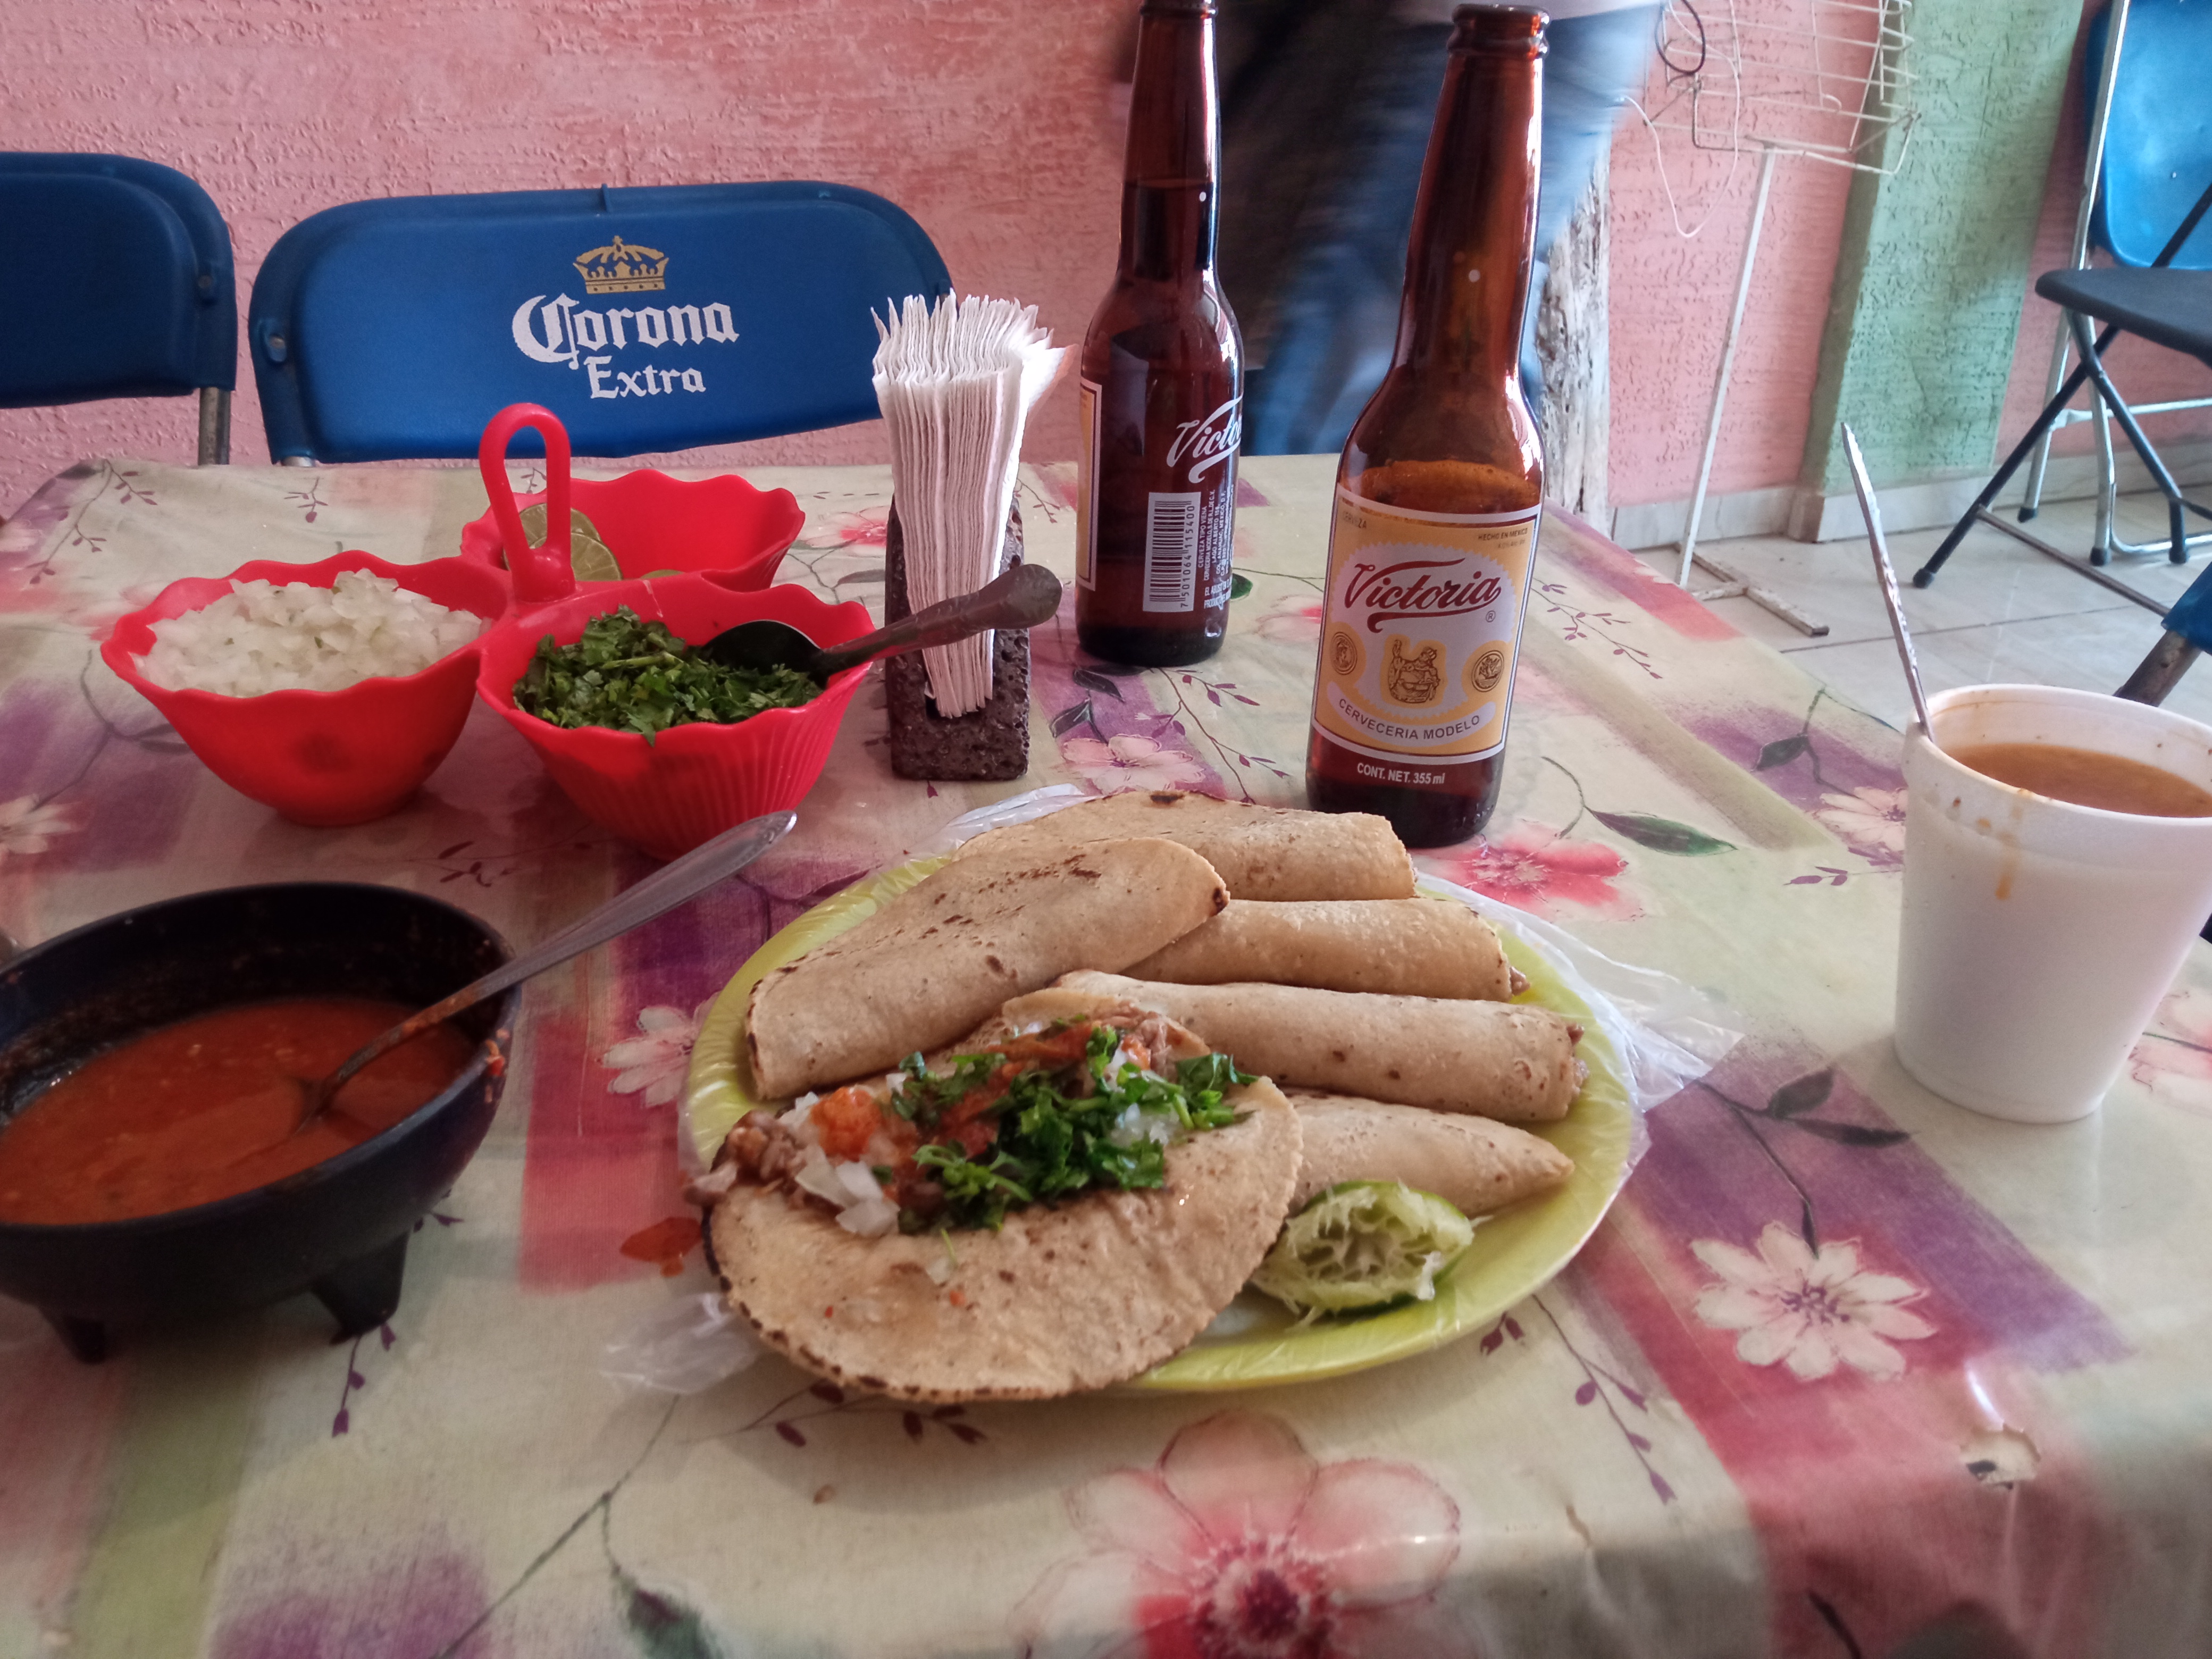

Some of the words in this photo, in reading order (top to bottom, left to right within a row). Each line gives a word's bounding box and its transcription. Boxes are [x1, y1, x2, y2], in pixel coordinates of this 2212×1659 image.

[512, 293, 740, 370] Corona
[584, 355, 706, 399] Extra
[1185, 506, 1195, 548] 115400
[1182, 555, 1192, 597] 501064
[1344, 558, 1502, 633] Victoria
[1339, 698, 1419, 740] CERVECERIA
[1423, 715, 1480, 740] MODELO
[1357, 763, 1386, 779] CONT.
[1388, 769, 1411, 783] NET.
[1413, 773, 1431, 784] 355
[1432, 773, 1446, 784] ml
